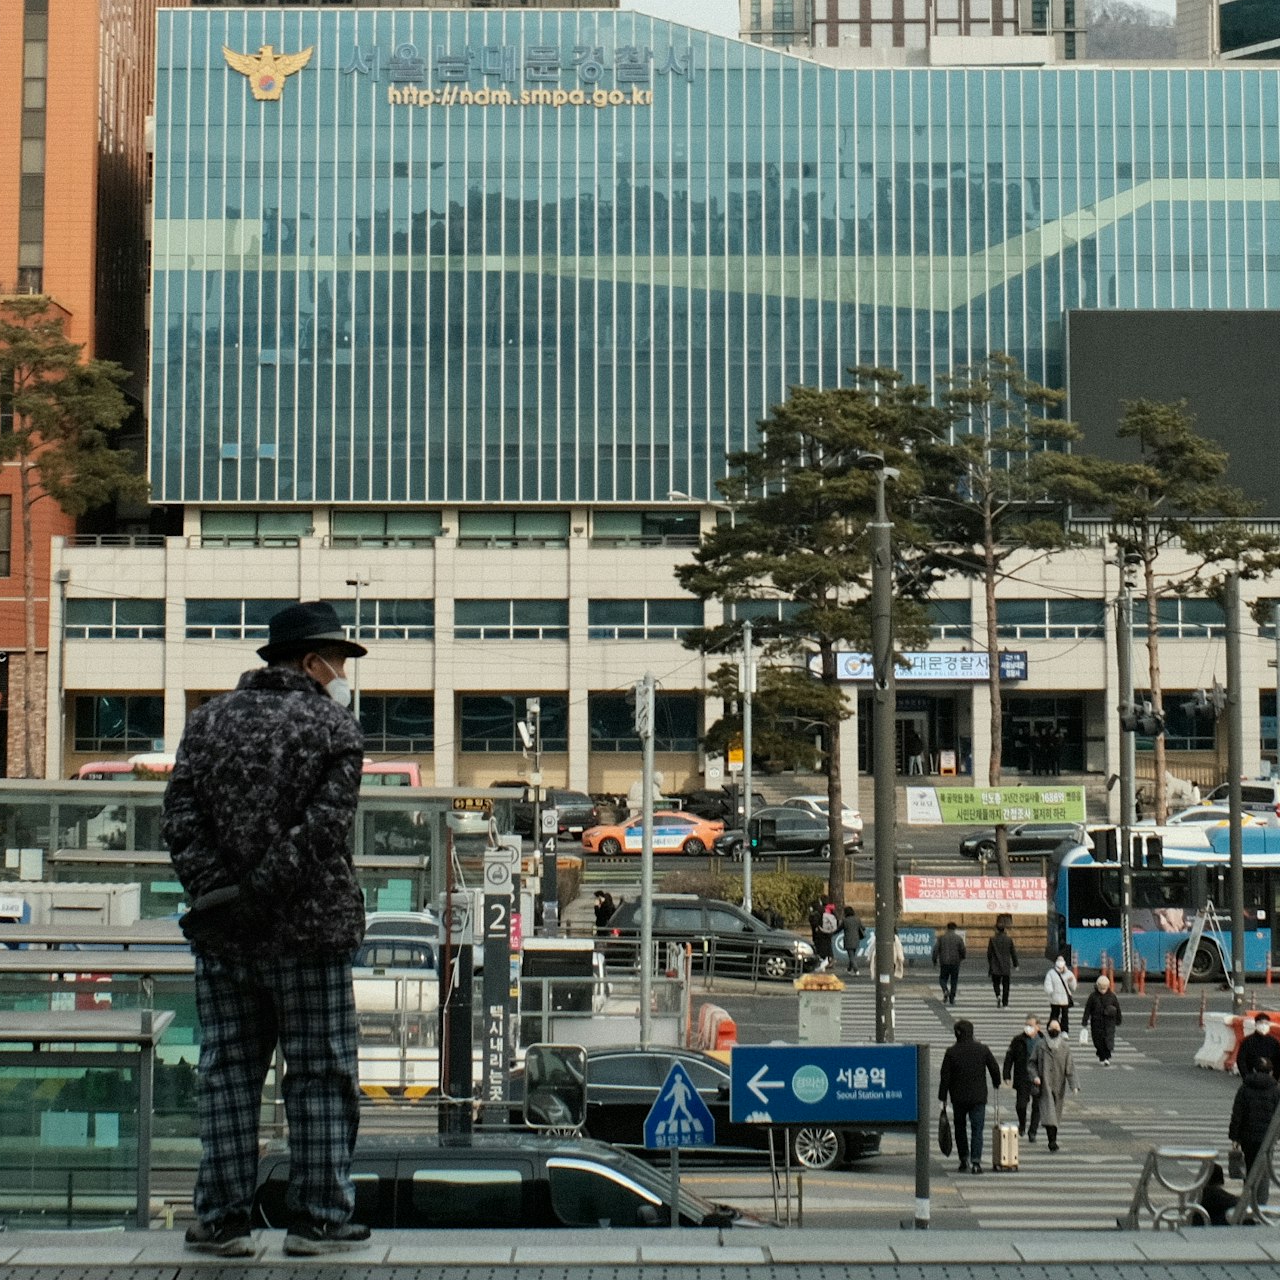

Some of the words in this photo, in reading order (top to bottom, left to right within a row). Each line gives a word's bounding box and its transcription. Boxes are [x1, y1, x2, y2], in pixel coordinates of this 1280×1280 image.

[343, 42, 695, 83] 서울남대문경찰서
[387, 86, 653, 106] http://ndm.smpa.go.kr
[897, 655, 989, 671] 대문경찰서
[545, 837, 556, 852] 4
[489, 904, 506, 930] 2
[489, 1004, 503, 1102] 택시내리는곳
[836, 1067, 886, 1089] 서울역
[836, 1090, 857, 1100] Seoul
[858, 1090, 884, 1100] Station
